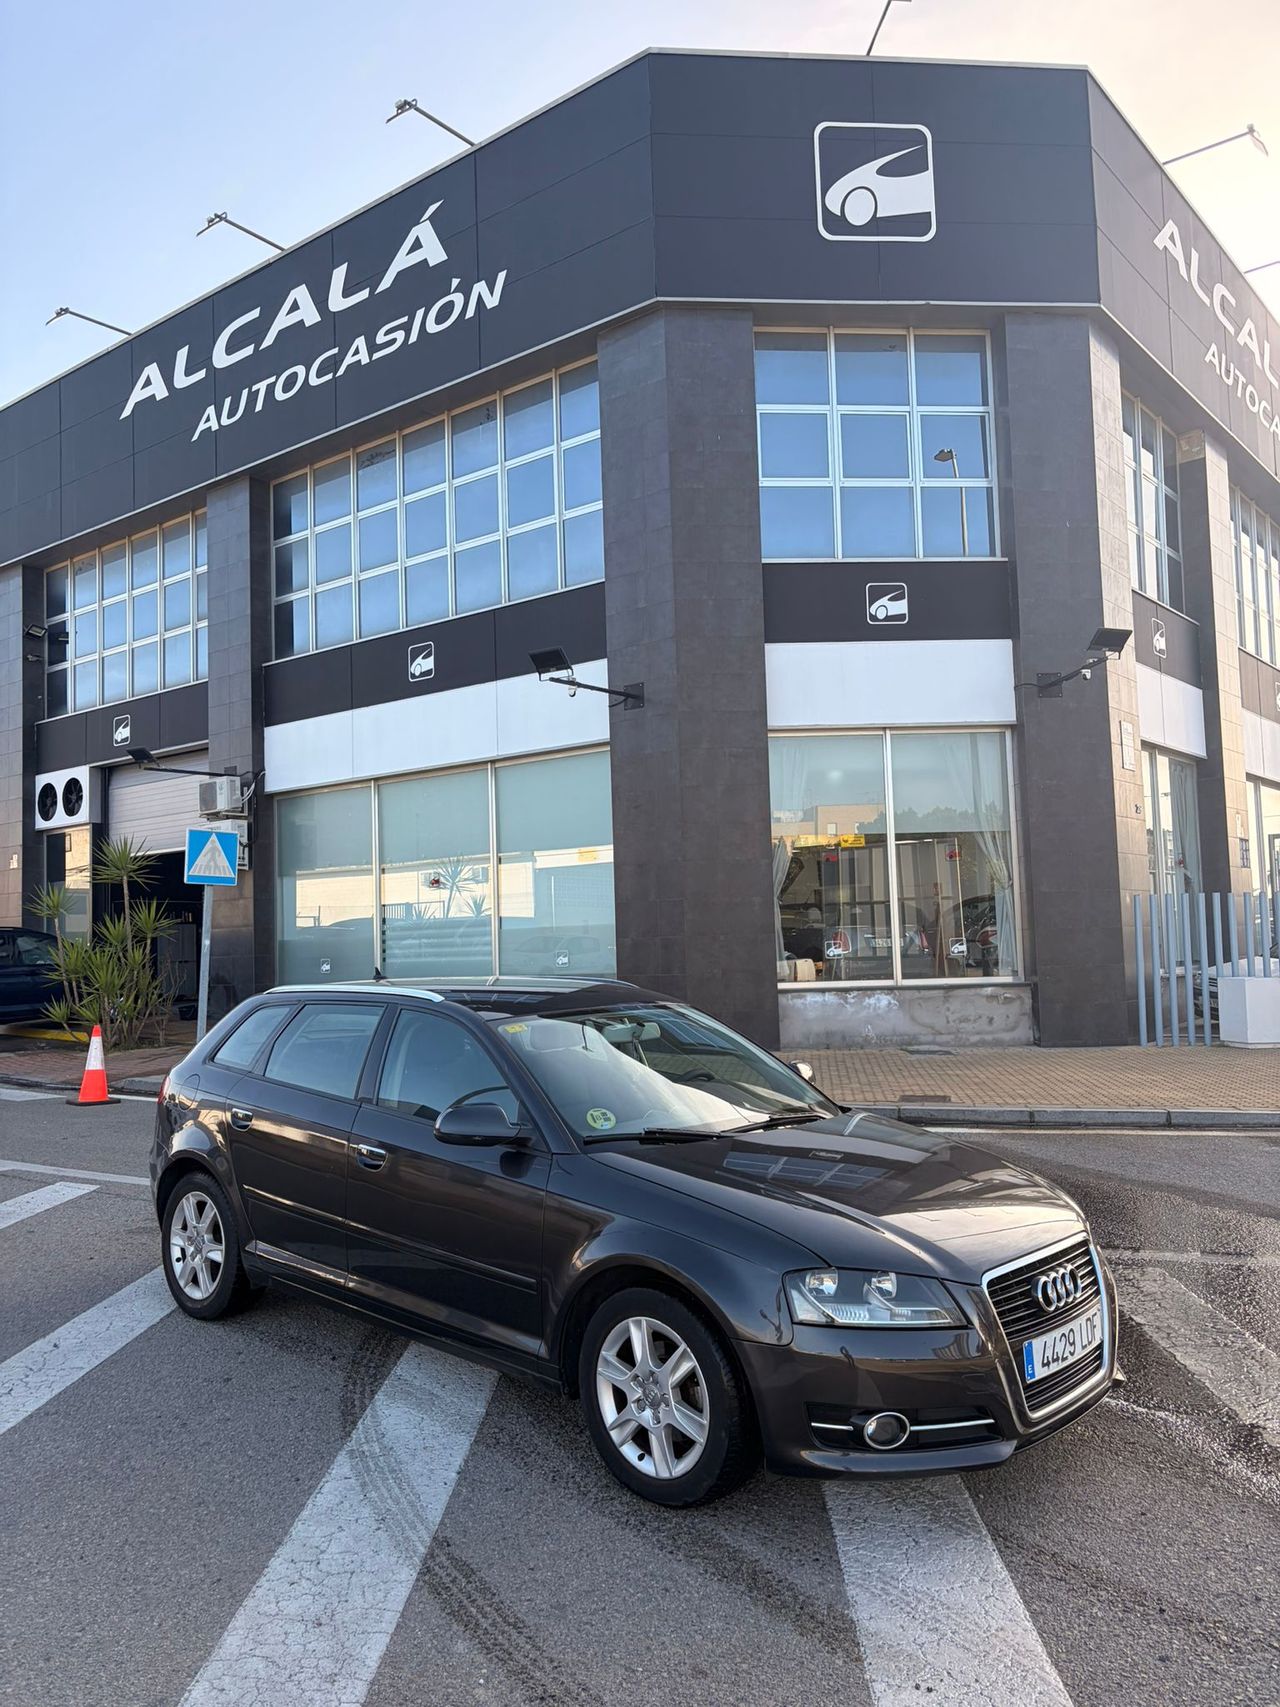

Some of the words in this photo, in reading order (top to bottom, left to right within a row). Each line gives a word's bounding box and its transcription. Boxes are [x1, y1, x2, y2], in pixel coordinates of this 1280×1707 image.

[119, 199, 449, 420] ALCALÁ
[190, 269, 508, 442] AUTOCASIÓN
[1041, 1327, 1076, 1369] 4429
[1079, 1312, 1097, 1350] LDF
